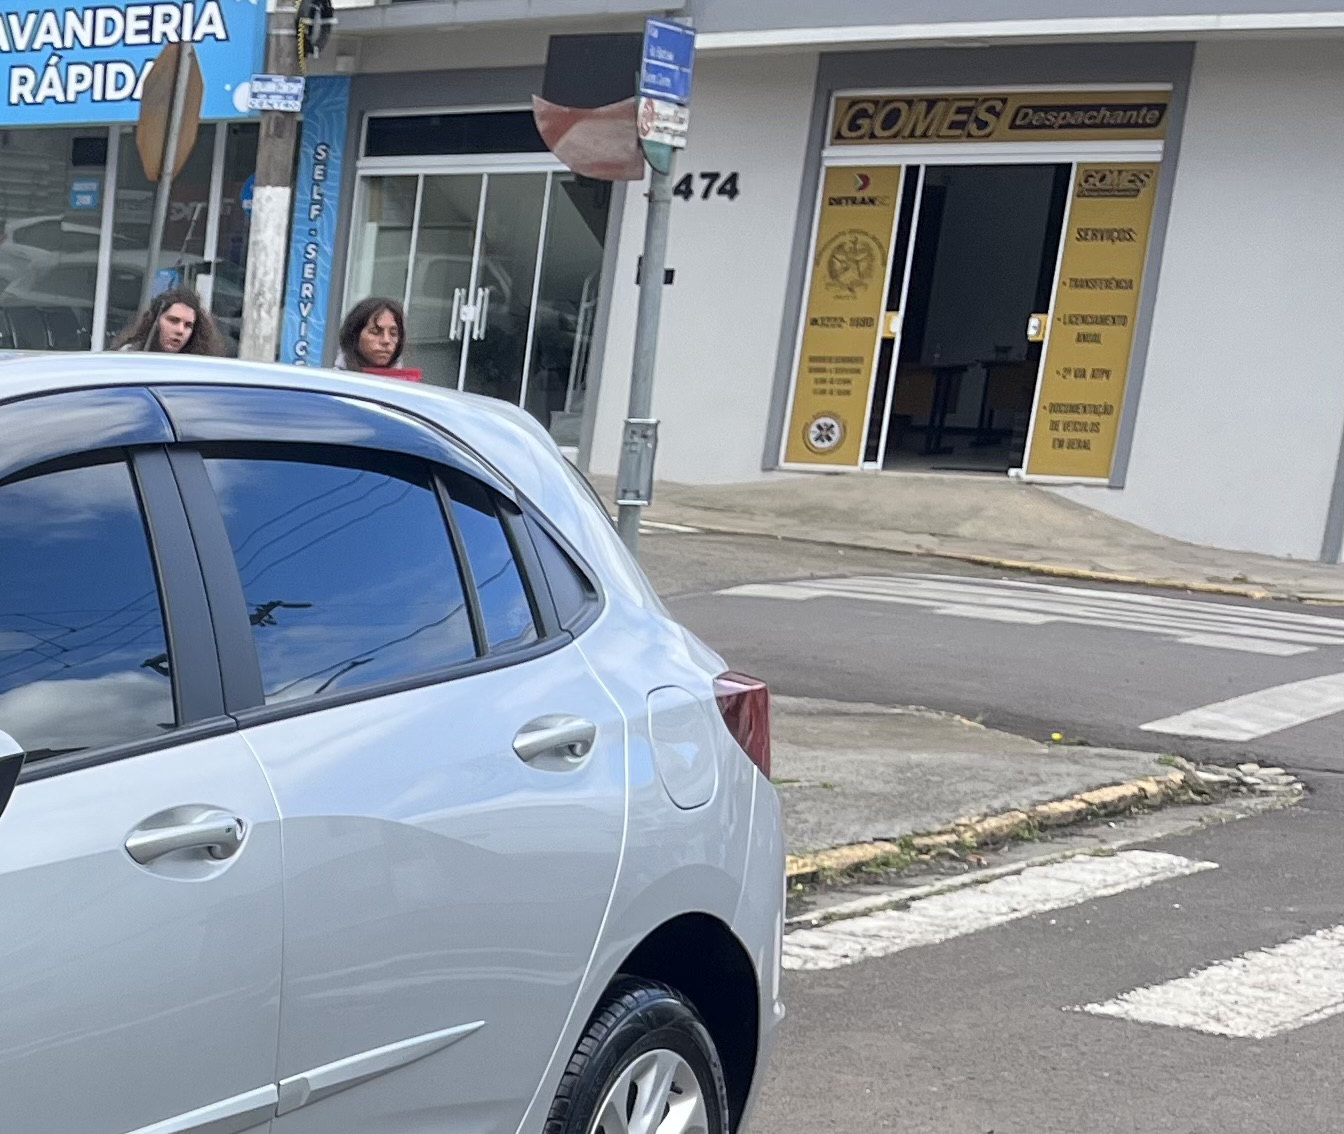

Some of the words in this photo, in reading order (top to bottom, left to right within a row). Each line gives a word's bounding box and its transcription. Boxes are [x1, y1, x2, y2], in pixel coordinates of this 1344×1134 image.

[836, 98, 1007, 139] GOMES
[1015, 106, 1161, 130] Despachante
[672, 172, 739, 201] 474
[293, 242, 319, 365] SERVIC
